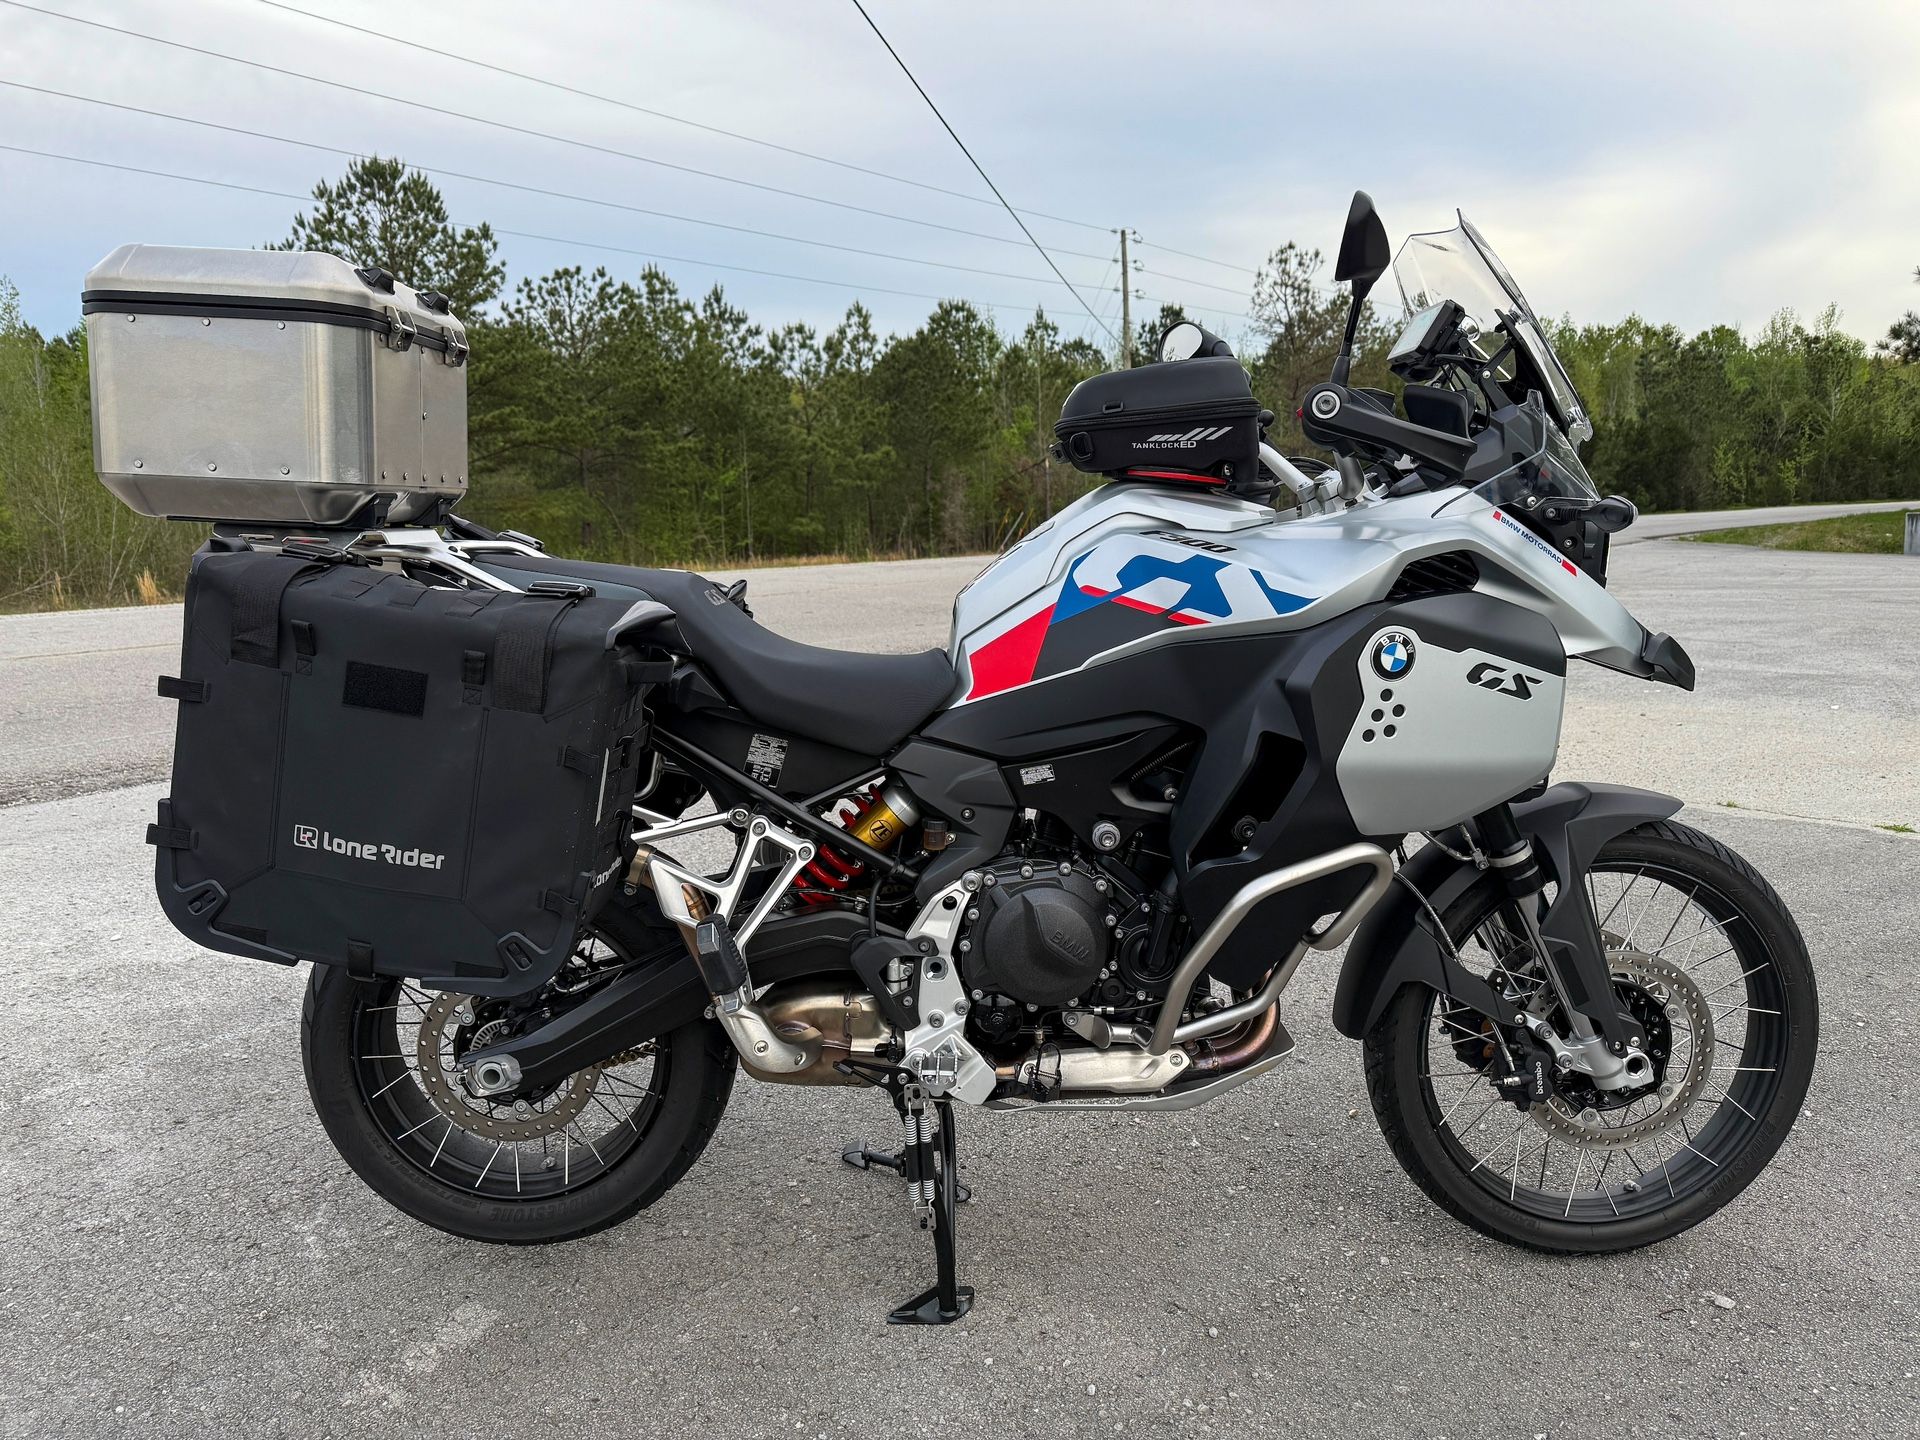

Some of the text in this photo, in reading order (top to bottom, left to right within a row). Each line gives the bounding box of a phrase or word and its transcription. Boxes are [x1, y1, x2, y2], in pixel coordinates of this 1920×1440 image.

[1131, 440, 1197, 449] TANKLOCKED
[1501, 516, 1562, 564] BMW MOTORRAD
[1380, 633, 1415, 655] BMW
[1466, 661, 1544, 701] GS
[322, 831, 377, 861] Lone
[380, 843, 446, 870] Rider
[1048, 929, 1090, 961] BMW
[1535, 1061, 1544, 1095] brembo
